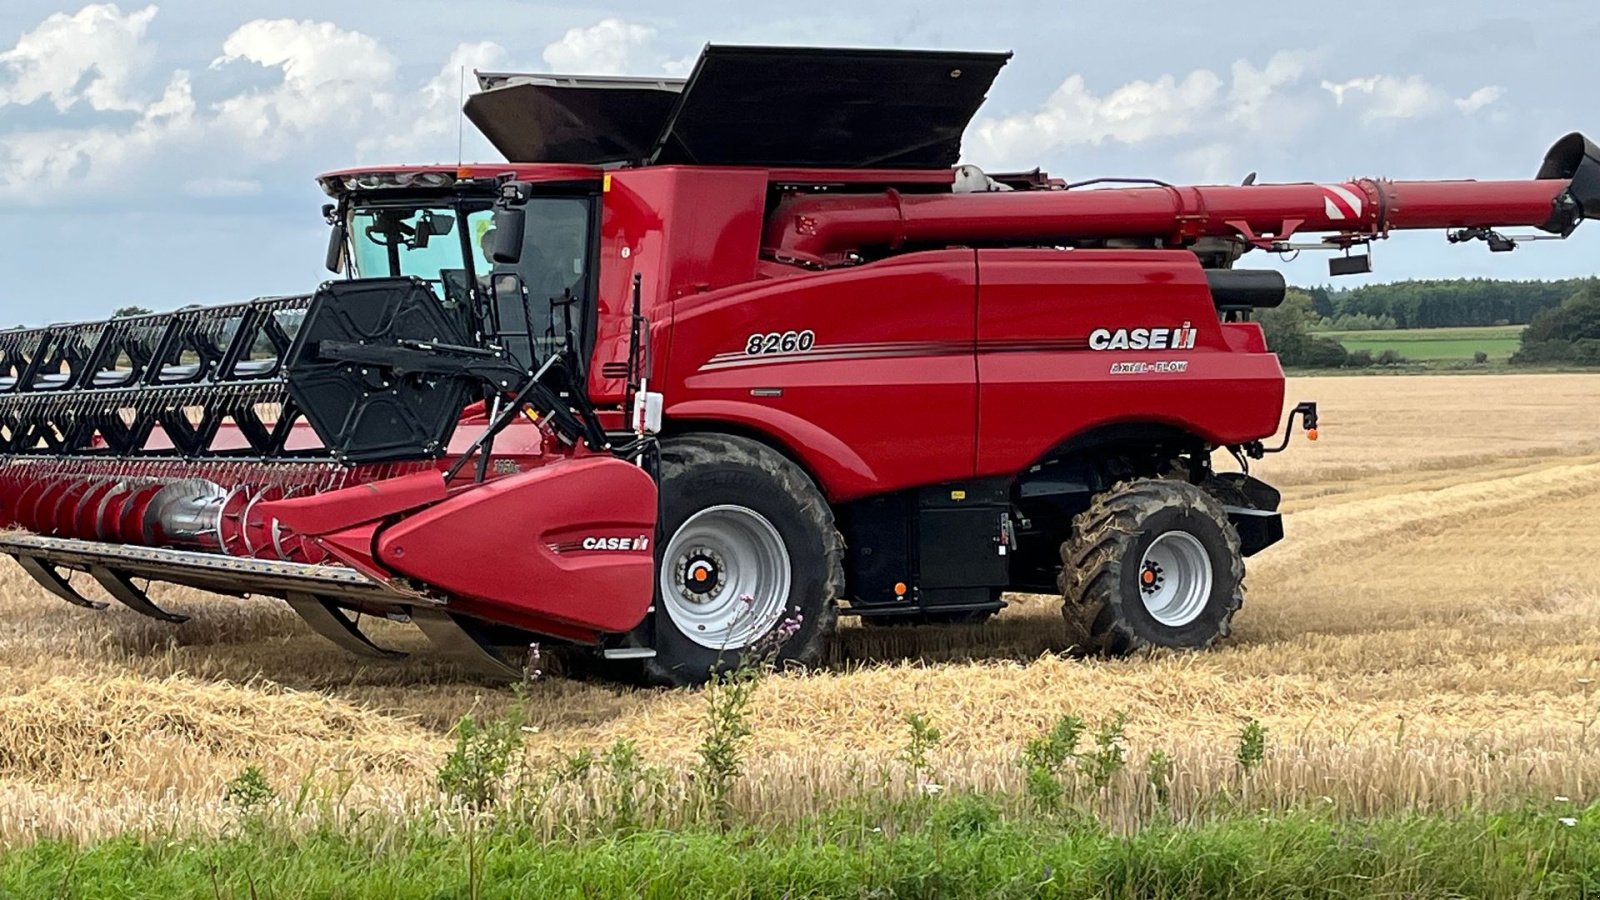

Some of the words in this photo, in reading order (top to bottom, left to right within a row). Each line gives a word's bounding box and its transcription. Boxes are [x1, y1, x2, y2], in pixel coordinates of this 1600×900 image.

[745, 330, 815, 355] 8260
[1089, 328, 1169, 350] CASE
[583, 537, 631, 550] CASE
